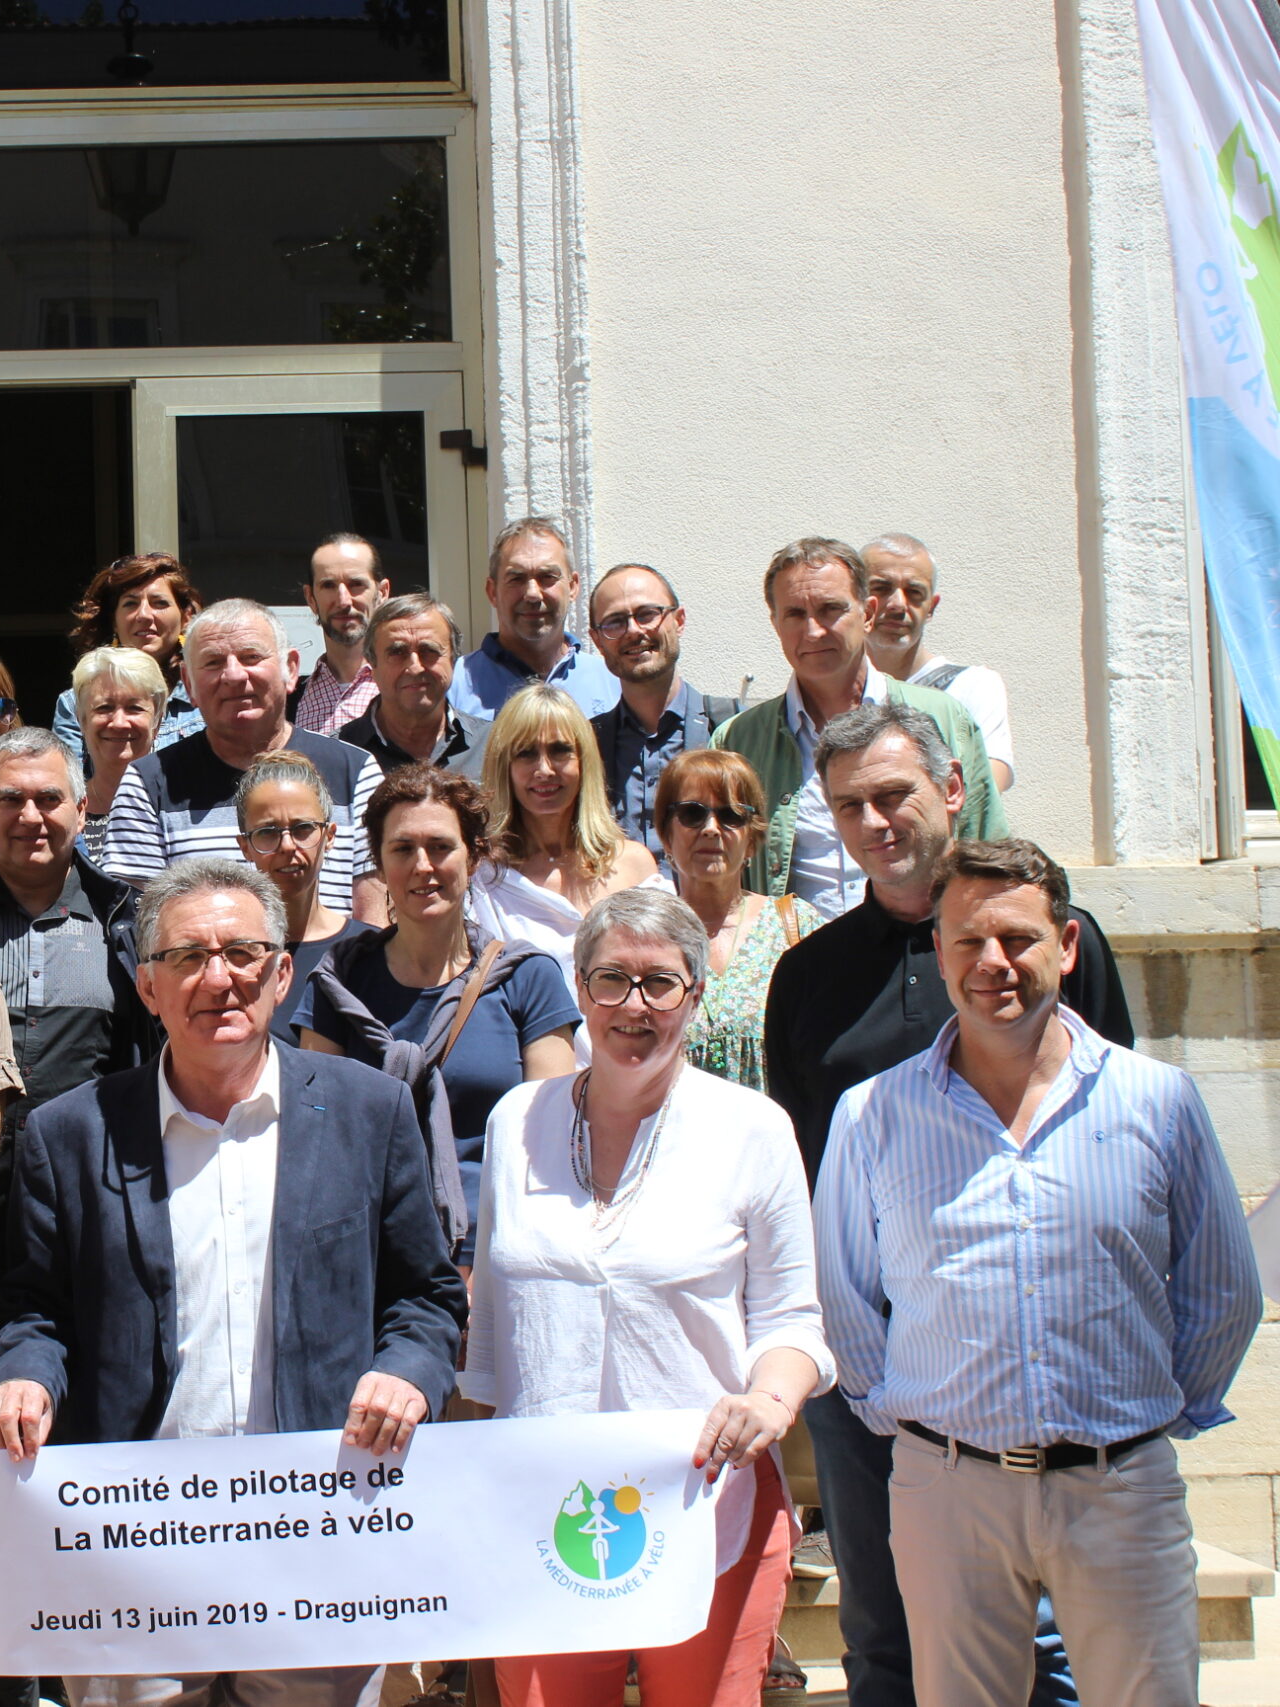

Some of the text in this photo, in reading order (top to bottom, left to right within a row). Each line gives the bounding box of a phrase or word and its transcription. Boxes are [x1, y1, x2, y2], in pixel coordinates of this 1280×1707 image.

[58, 1462, 404, 1507] Comité de pilotage de
[54, 1507, 414, 1552] La Méditerranée à vélo
[536, 1530, 665, 1600] LA MÉDITERRANÉE À VÉLO
[30, 1608, 102, 1631] Jeudi
[111, 1607, 141, 1629] 13
[147, 1606, 198, 1634] juin
[207, 1602, 268, 1626] 2019
[294, 1594, 448, 1623] Draguignan
